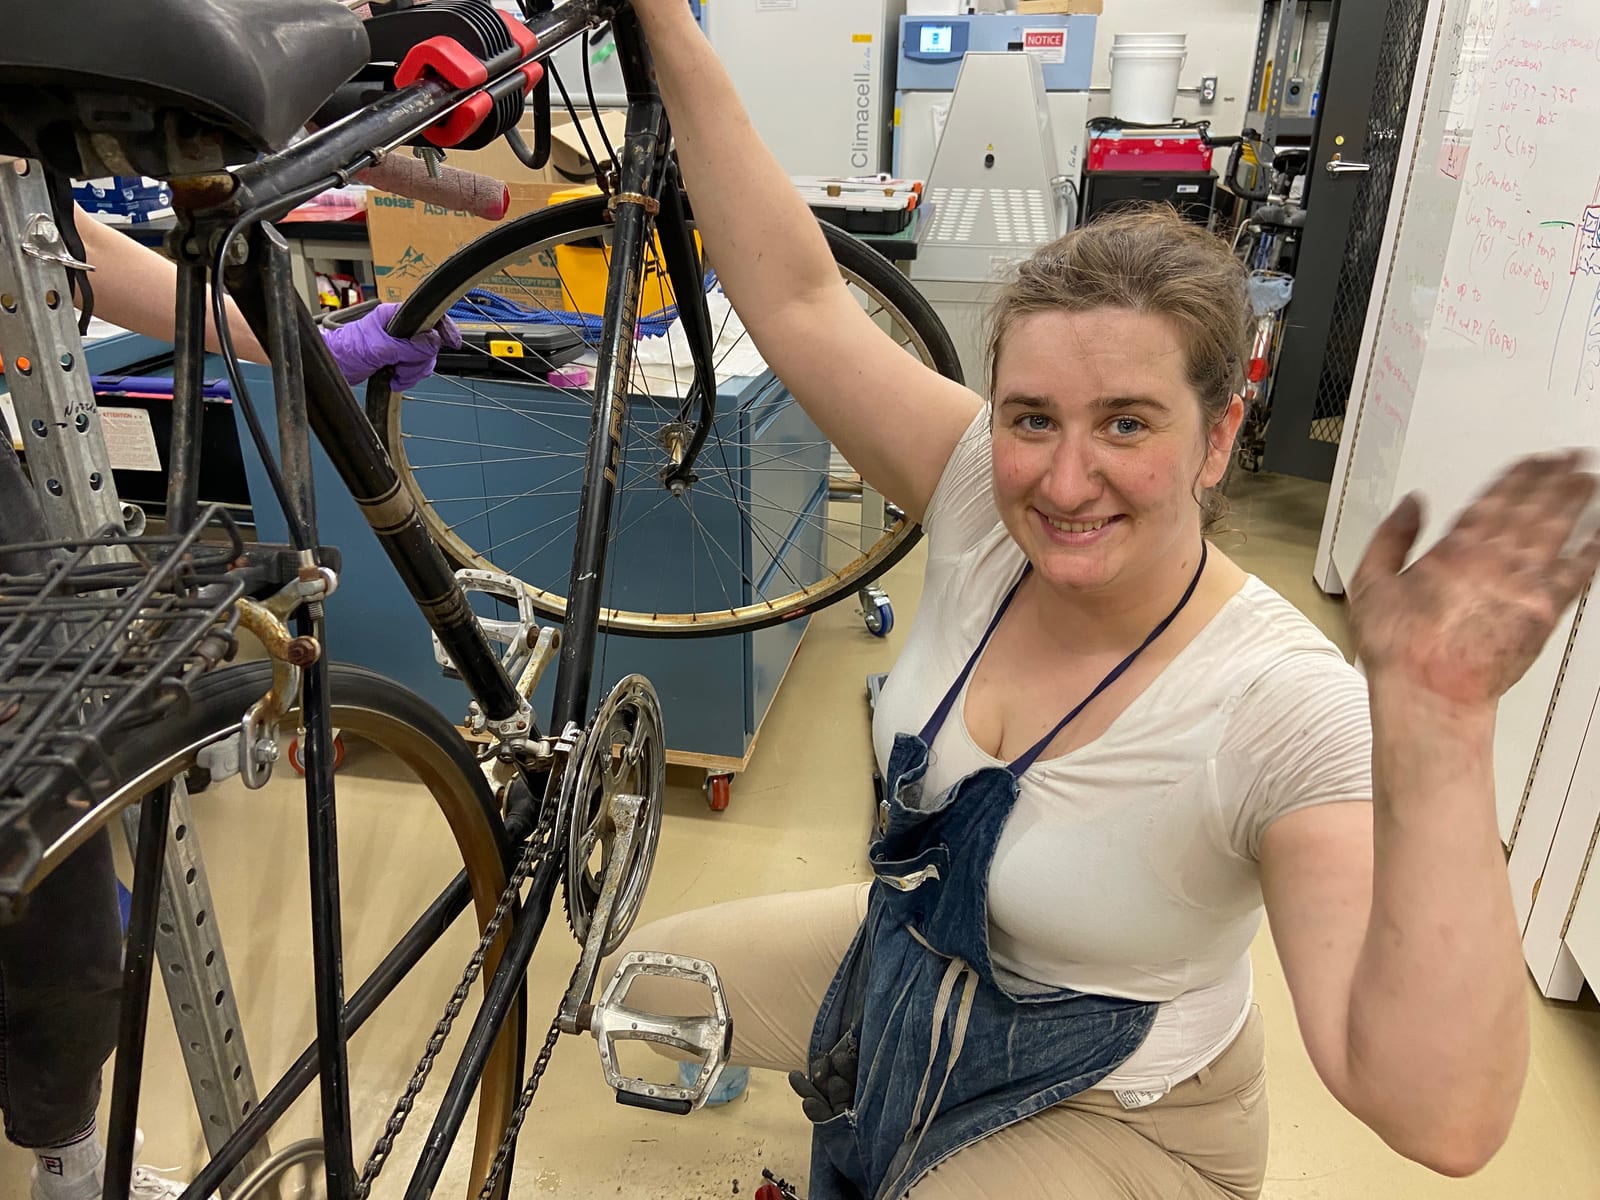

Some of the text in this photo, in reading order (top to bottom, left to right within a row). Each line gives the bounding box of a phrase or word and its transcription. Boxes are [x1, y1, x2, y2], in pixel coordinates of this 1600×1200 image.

[1027, 35, 1062, 46] NOTICE
[851, 73, 870, 169] Climacell
[522, 278, 536, 286] COPY
[537, 279, 557, 287] PAPER
